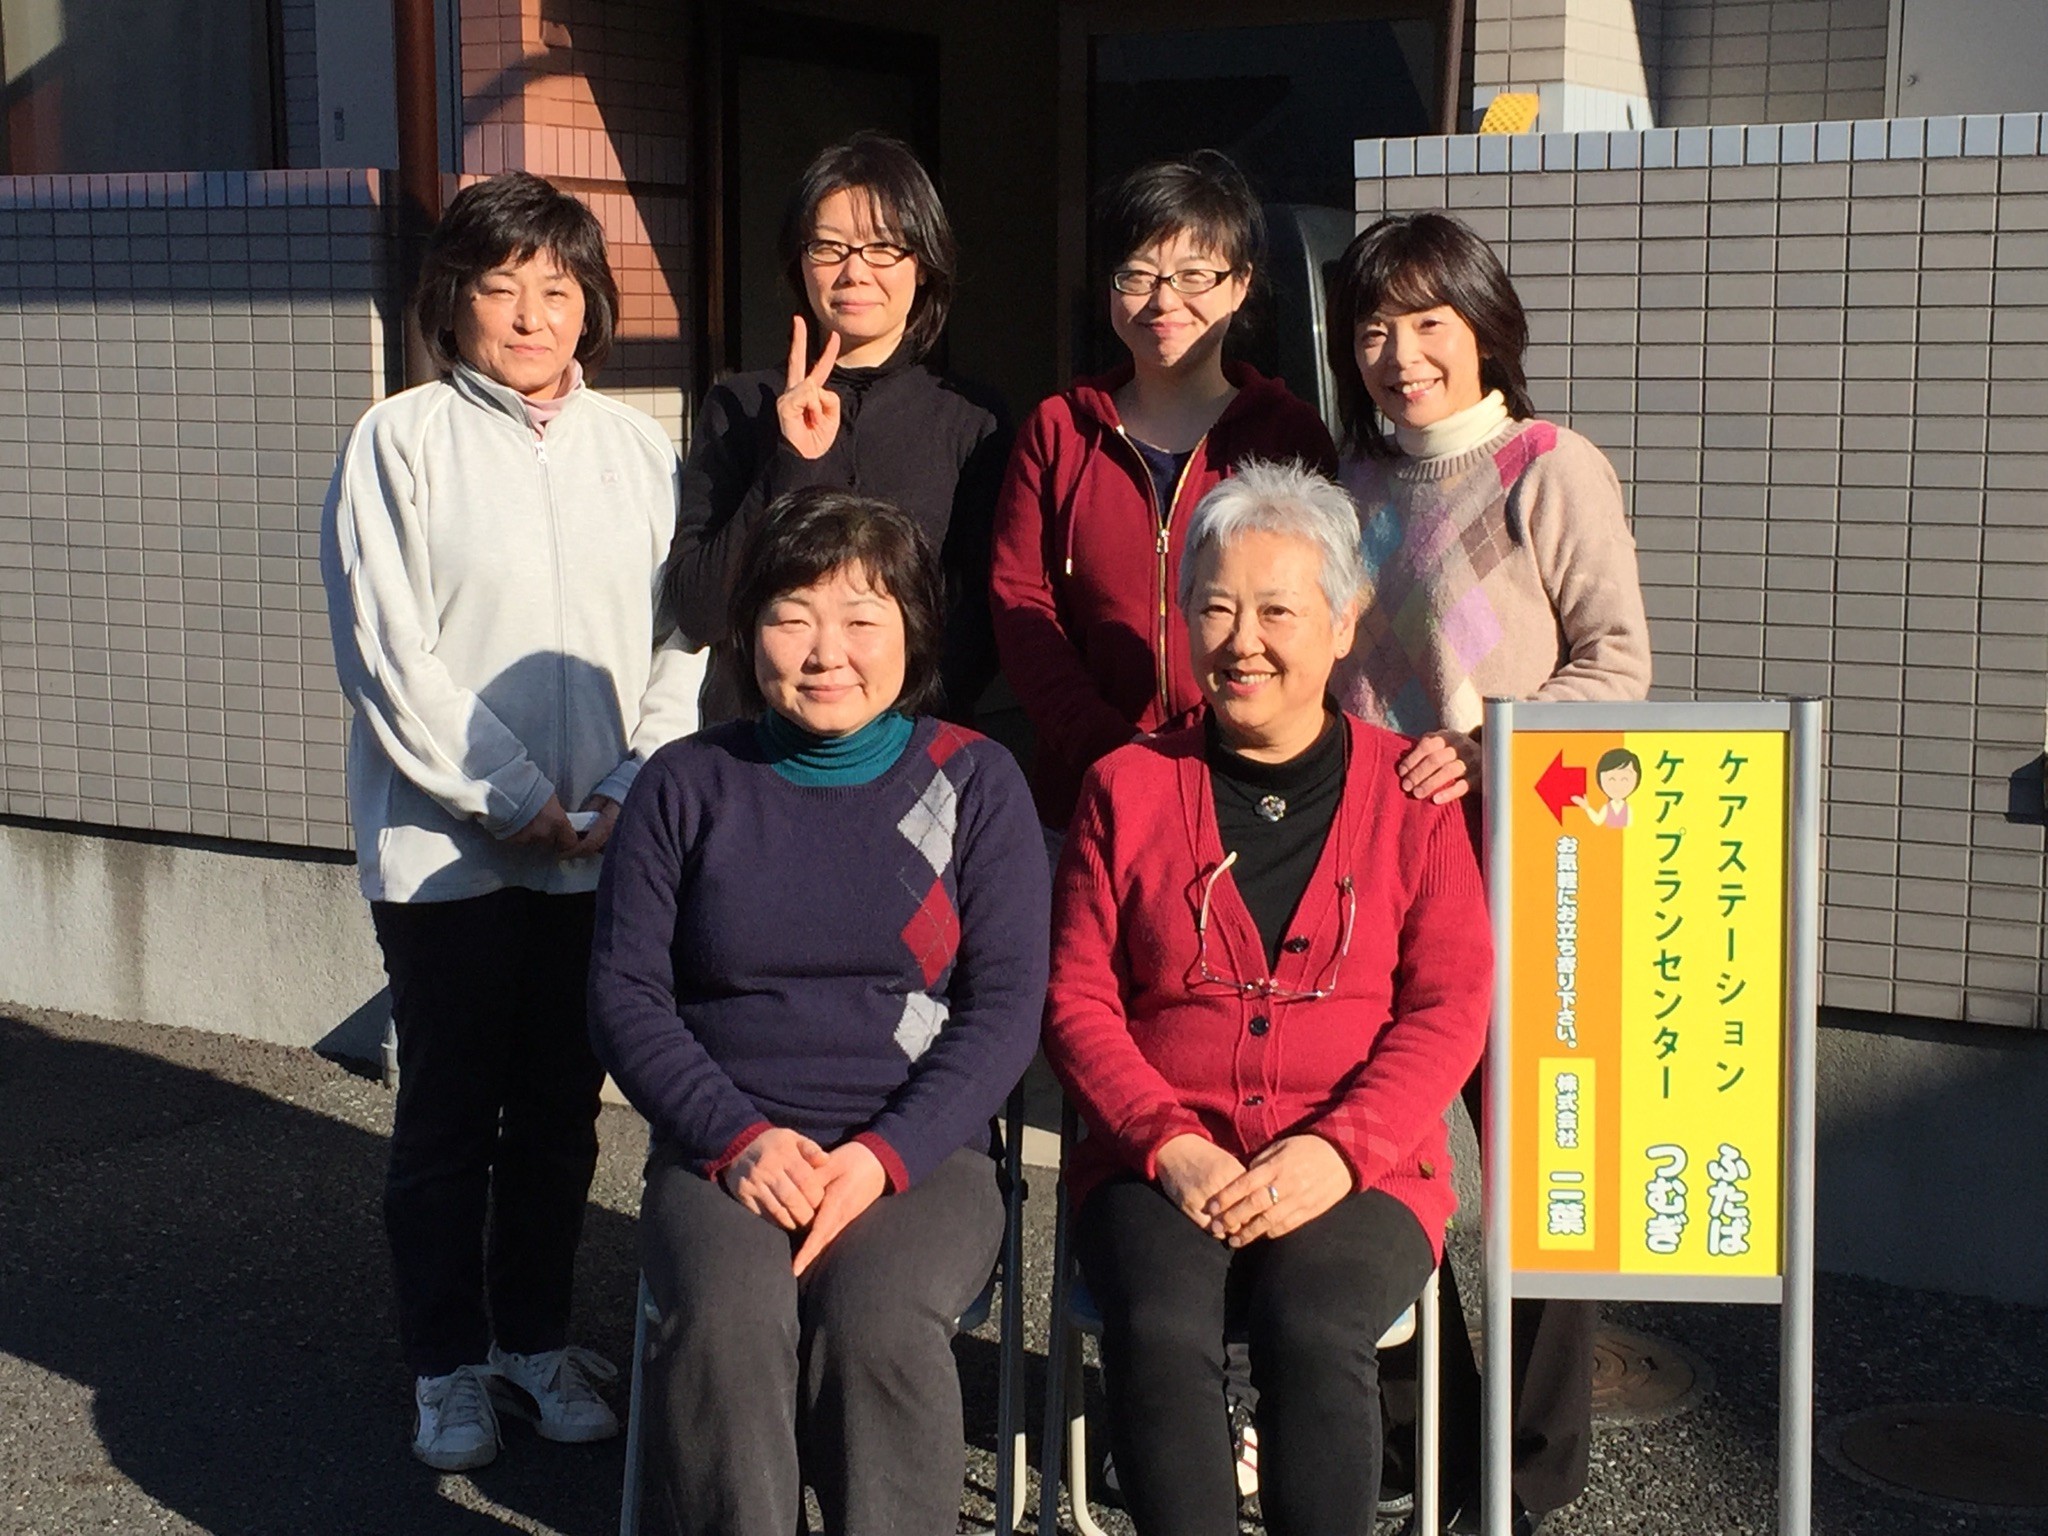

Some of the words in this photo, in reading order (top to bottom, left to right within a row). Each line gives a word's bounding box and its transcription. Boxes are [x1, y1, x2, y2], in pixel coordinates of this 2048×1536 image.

[1652, 749, 1687, 1100] ケアプランセンター
[1715, 749, 1749, 1094] ケアステーション
[1555, 1072, 1579, 1149] 株式会社
[1548, 1171, 1586, 1235] 二葉
[1645, 1144, 1689, 1254] つむぎ
[1707, 1143, 1751, 1256] ふたば
